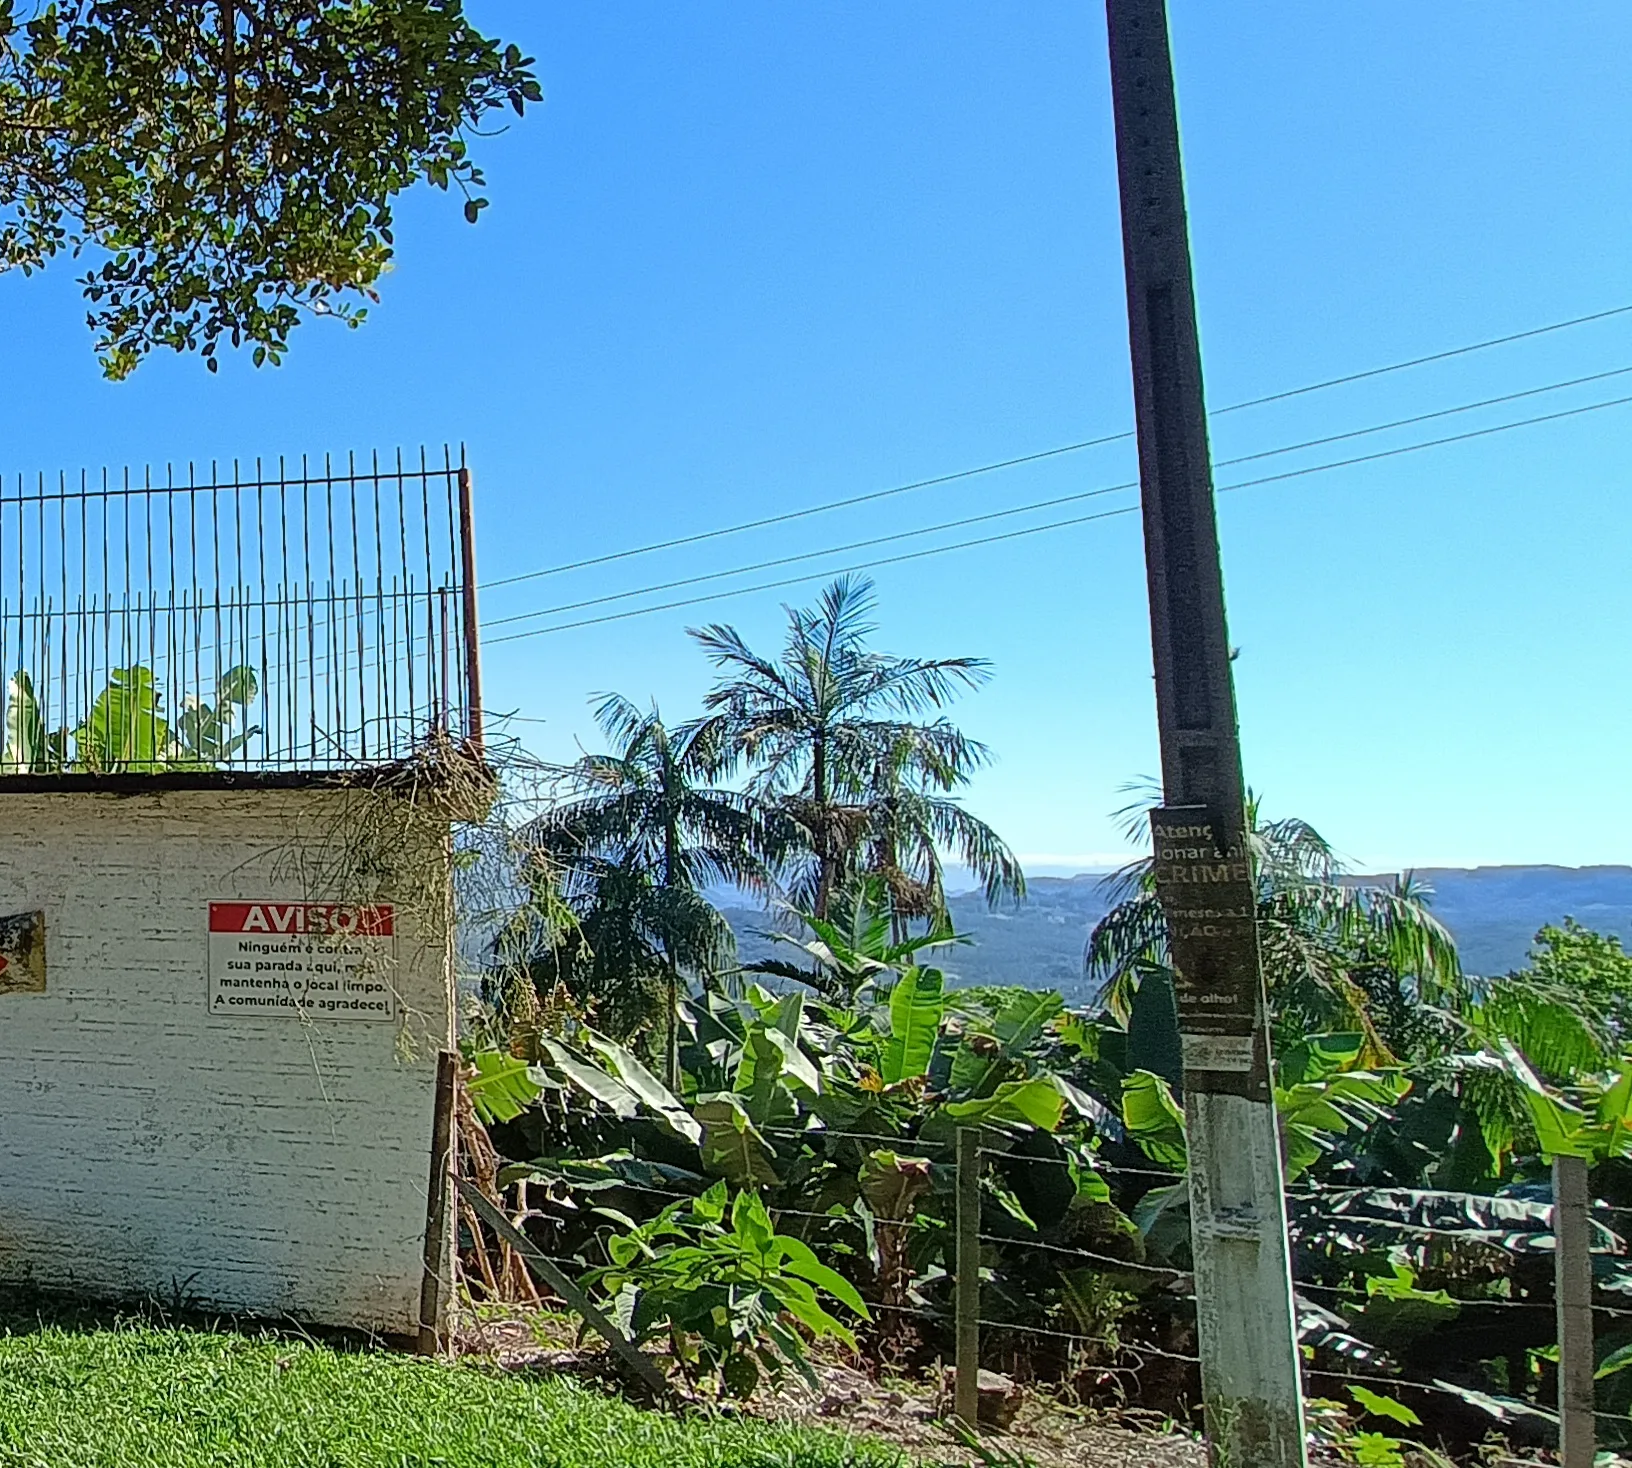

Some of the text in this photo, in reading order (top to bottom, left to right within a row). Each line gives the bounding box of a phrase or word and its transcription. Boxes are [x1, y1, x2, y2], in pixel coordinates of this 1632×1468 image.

[1155, 863, 1248, 883] CRIME
[238, 941, 301, 955] Ninguém
[227, 960, 251, 970] sua
[256, 960, 303, 972] parada
[220, 978, 387, 994] mantenha o local limpo.
[215, 994, 388, 1012] A comunidade agradece!
